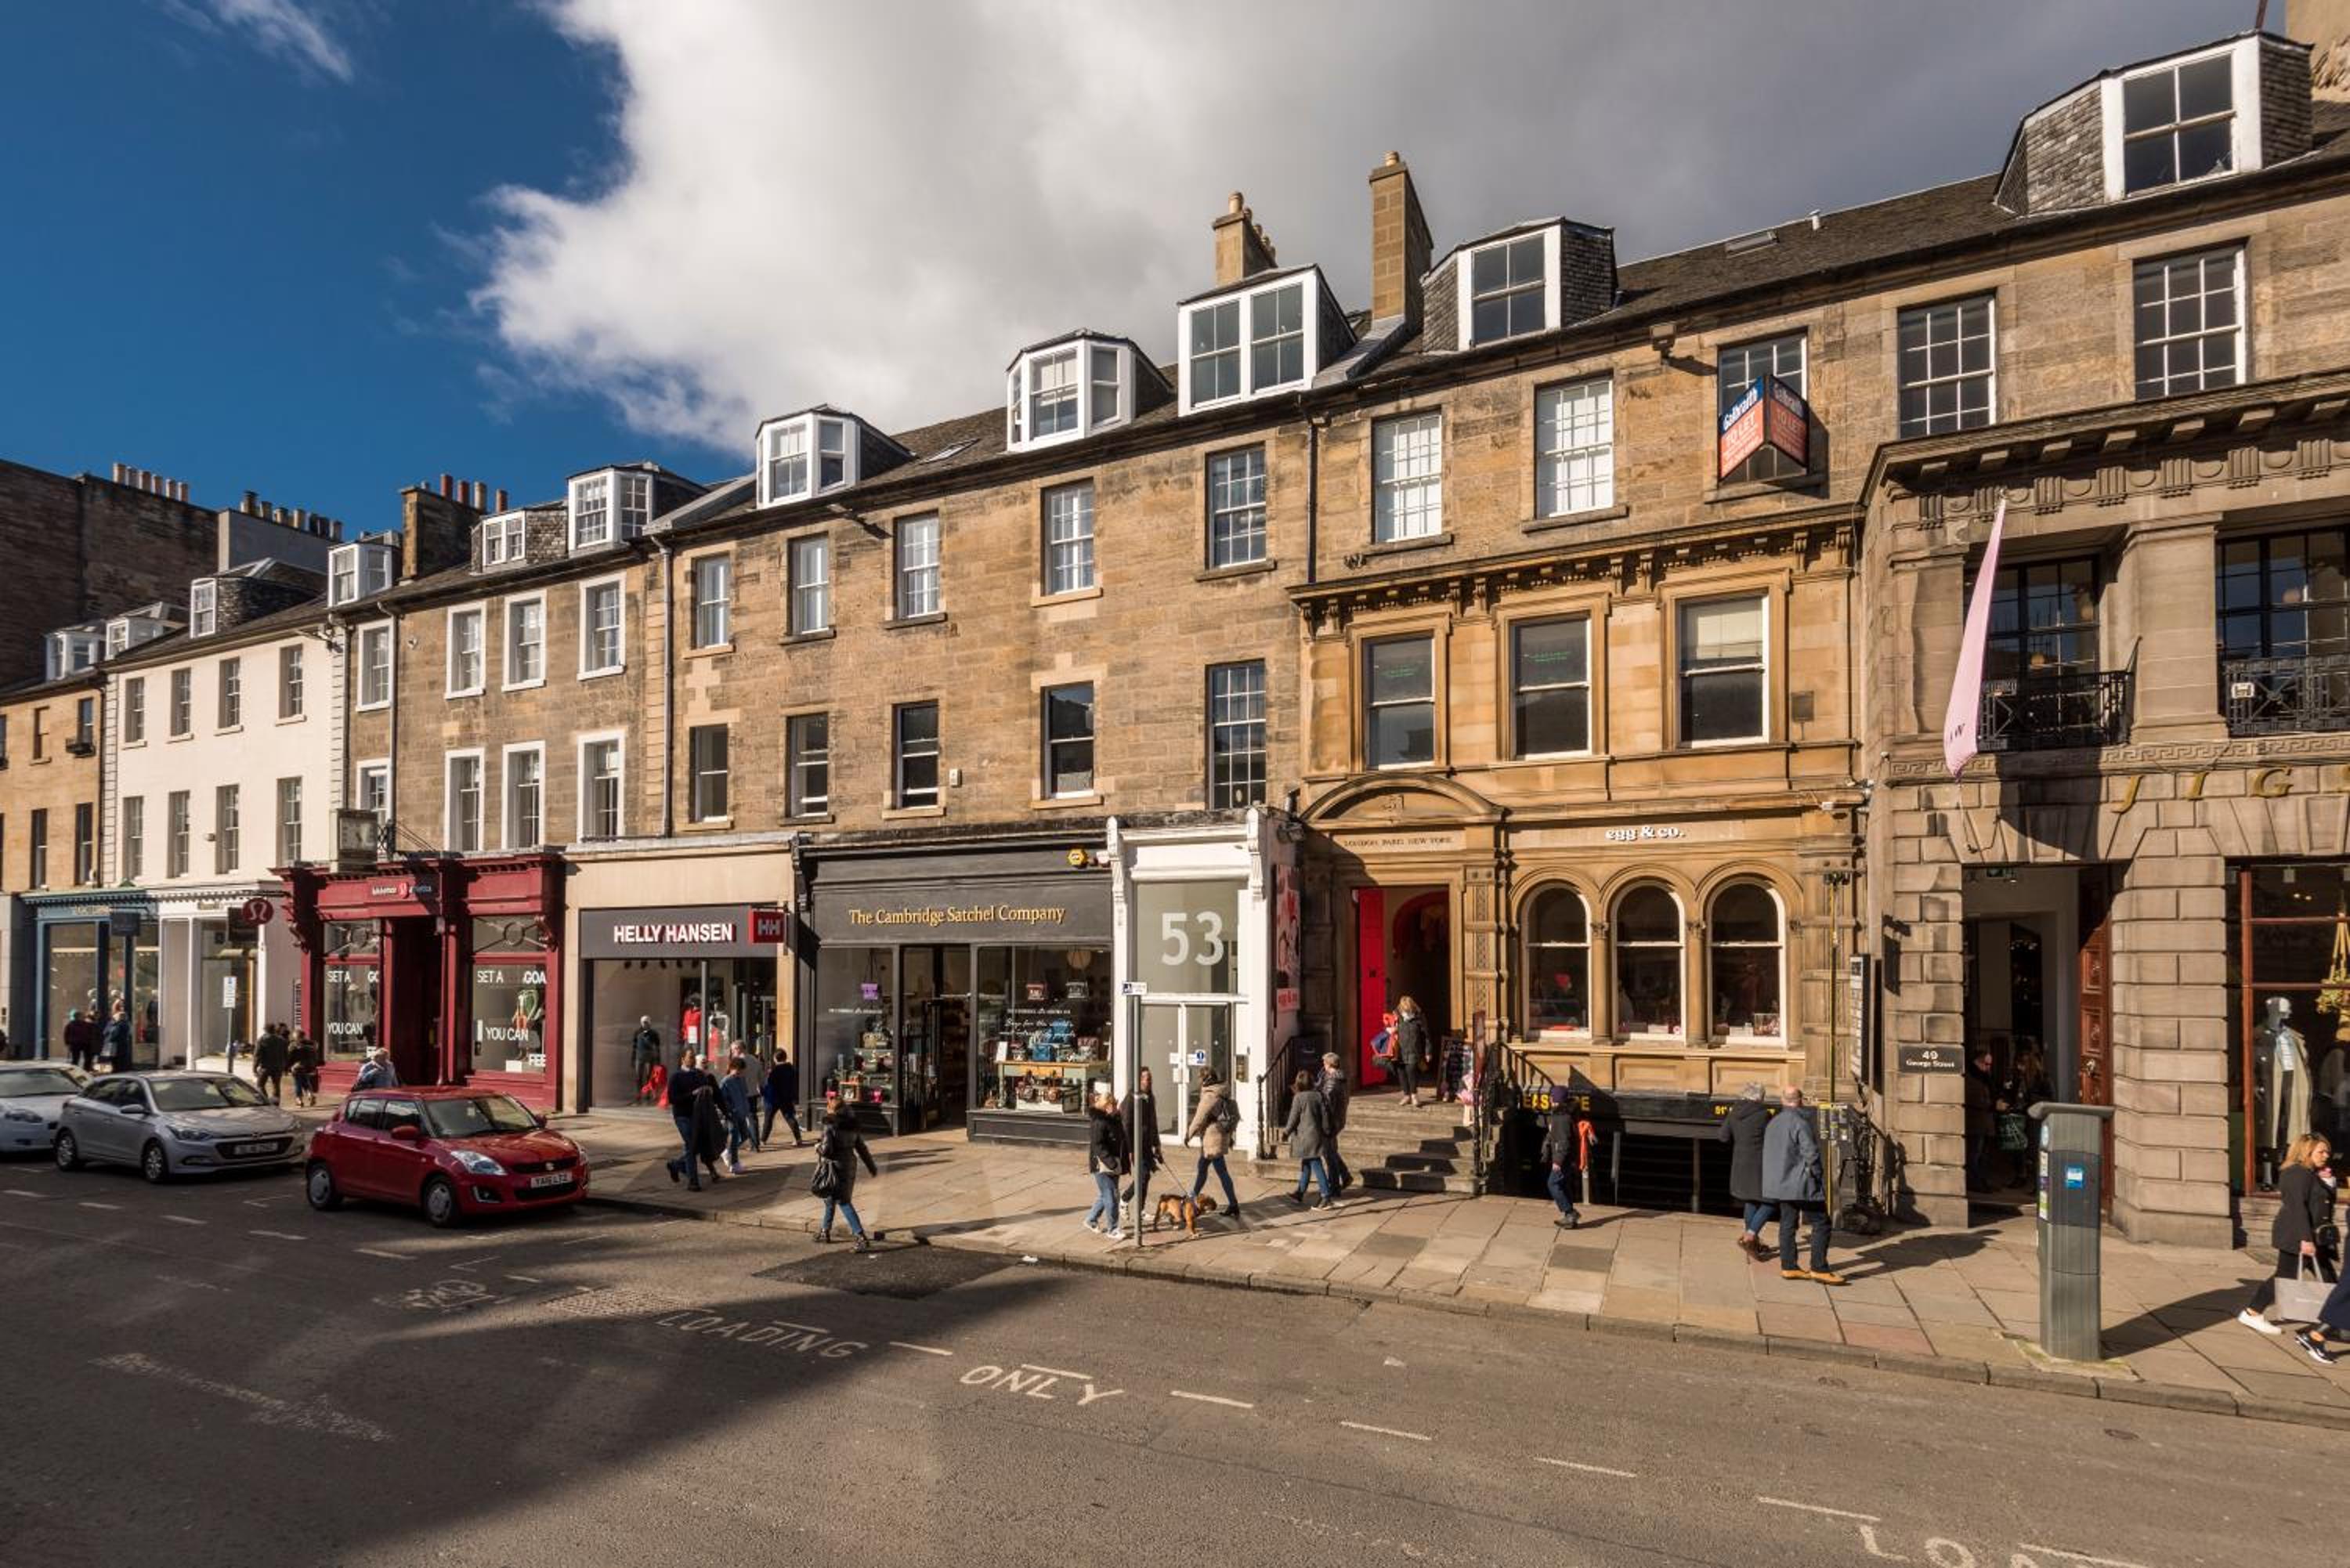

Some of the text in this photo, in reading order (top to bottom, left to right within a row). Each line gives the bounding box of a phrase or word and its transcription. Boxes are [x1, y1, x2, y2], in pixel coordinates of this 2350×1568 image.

[2112, 764, 2350, 814] JIG
[1408, 836, 1426, 845] NEW
[1605, 829, 1637, 841] egg
[1641, 825, 1656, 839] &
[849, 904, 1066, 927] The Cambridge Satchel Company
[613, 923, 733, 943] HELLY HANSEN
[757, 919, 781, 936] HH
[1161, 911, 1224, 966] 53
[327, 970, 343, 983] SET
[345, 970, 352, 983] A
[477, 970, 495, 984] SET
[496, 970, 504, 984] A
[327, 1022, 363, 1035] YOU CAN
[486, 1027, 529, 1041] YOU CAN
[1922, 1050, 1939, 1060] 49
[1906, 1059, 1955, 1068] George Street
[656, 1310, 868, 1358] LOADING
[960, 1365, 1125, 1406] ONLY
